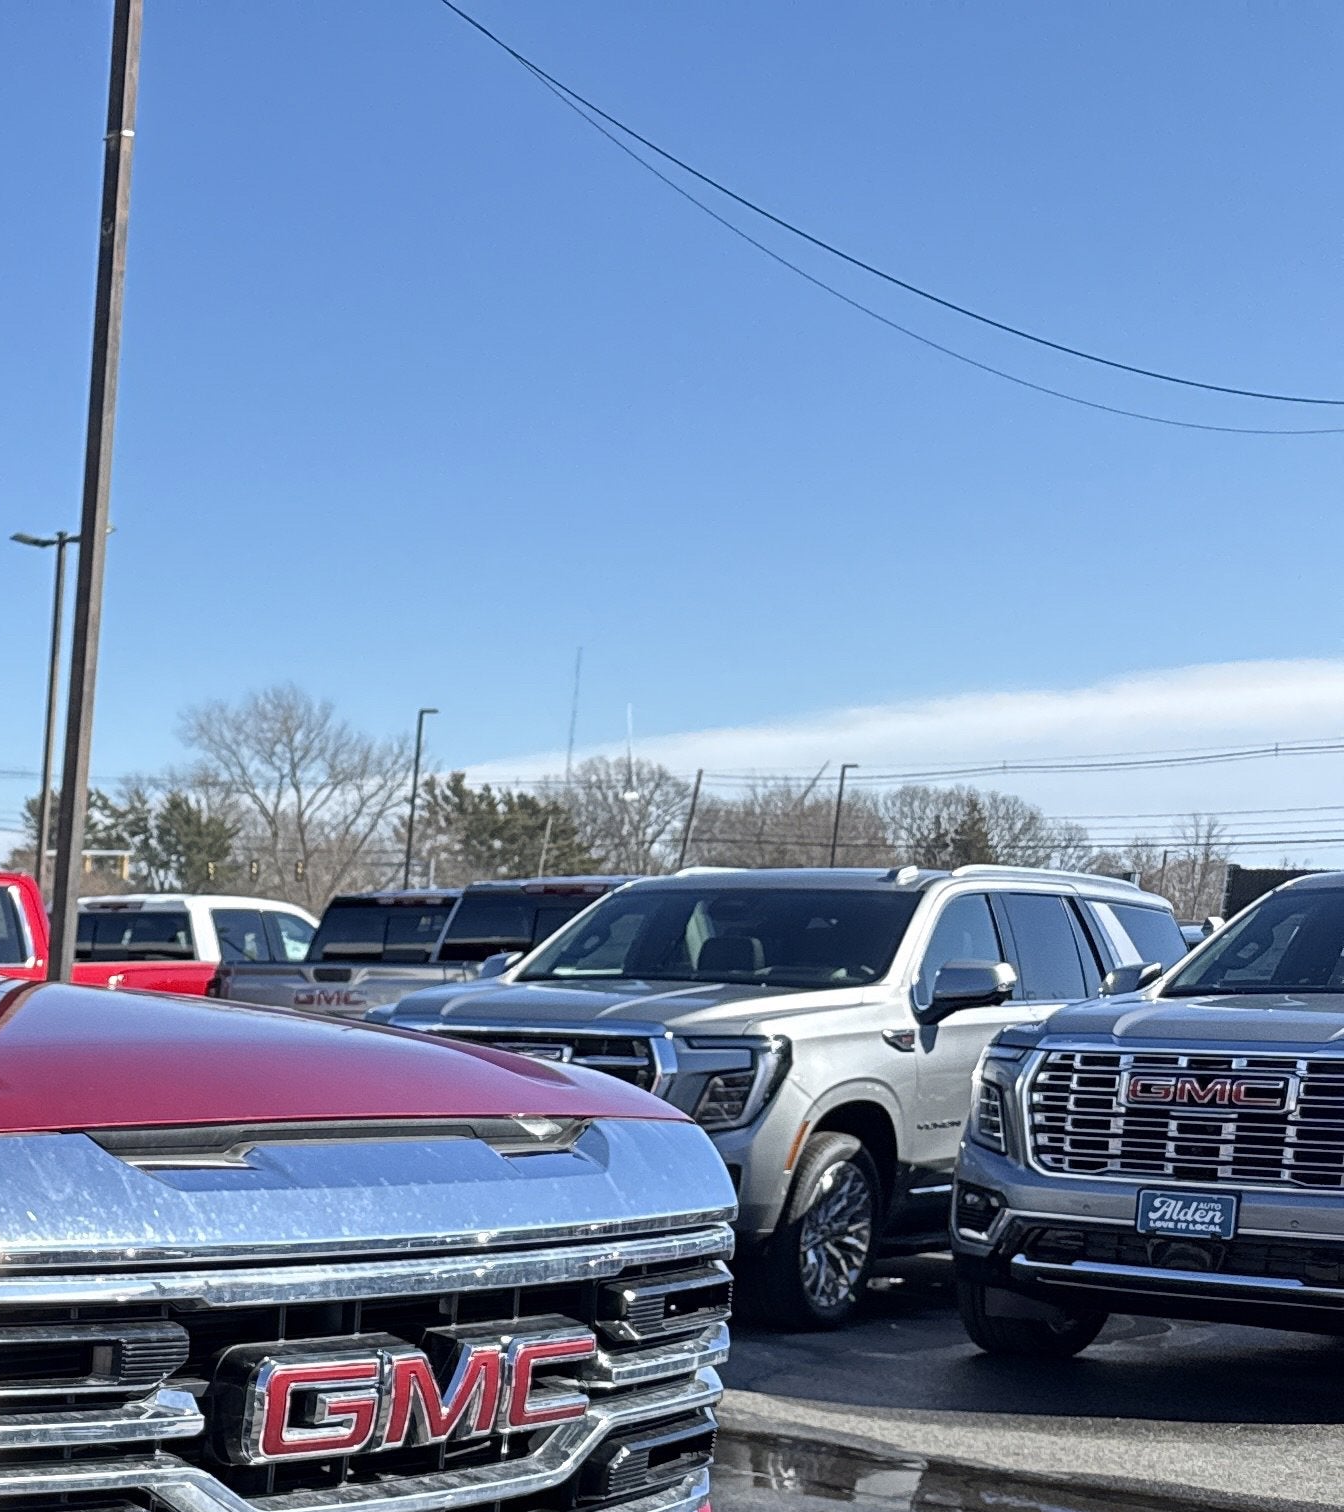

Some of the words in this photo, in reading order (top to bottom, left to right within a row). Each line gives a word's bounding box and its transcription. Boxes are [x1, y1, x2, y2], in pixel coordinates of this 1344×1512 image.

[294, 989, 367, 1006] GMC
[1129, 1076, 1285, 1107] GMC
[1148, 1197, 1224, 1223] Alden
[1198, 1201, 1222, 1211] AUTO
[1149, 1219, 1175, 1229] LOVE
[1177, 1221, 1186, 1230] IT
[1188, 1222, 1222, 1232] LOCAL
[244, 1330, 597, 1464] GMC
